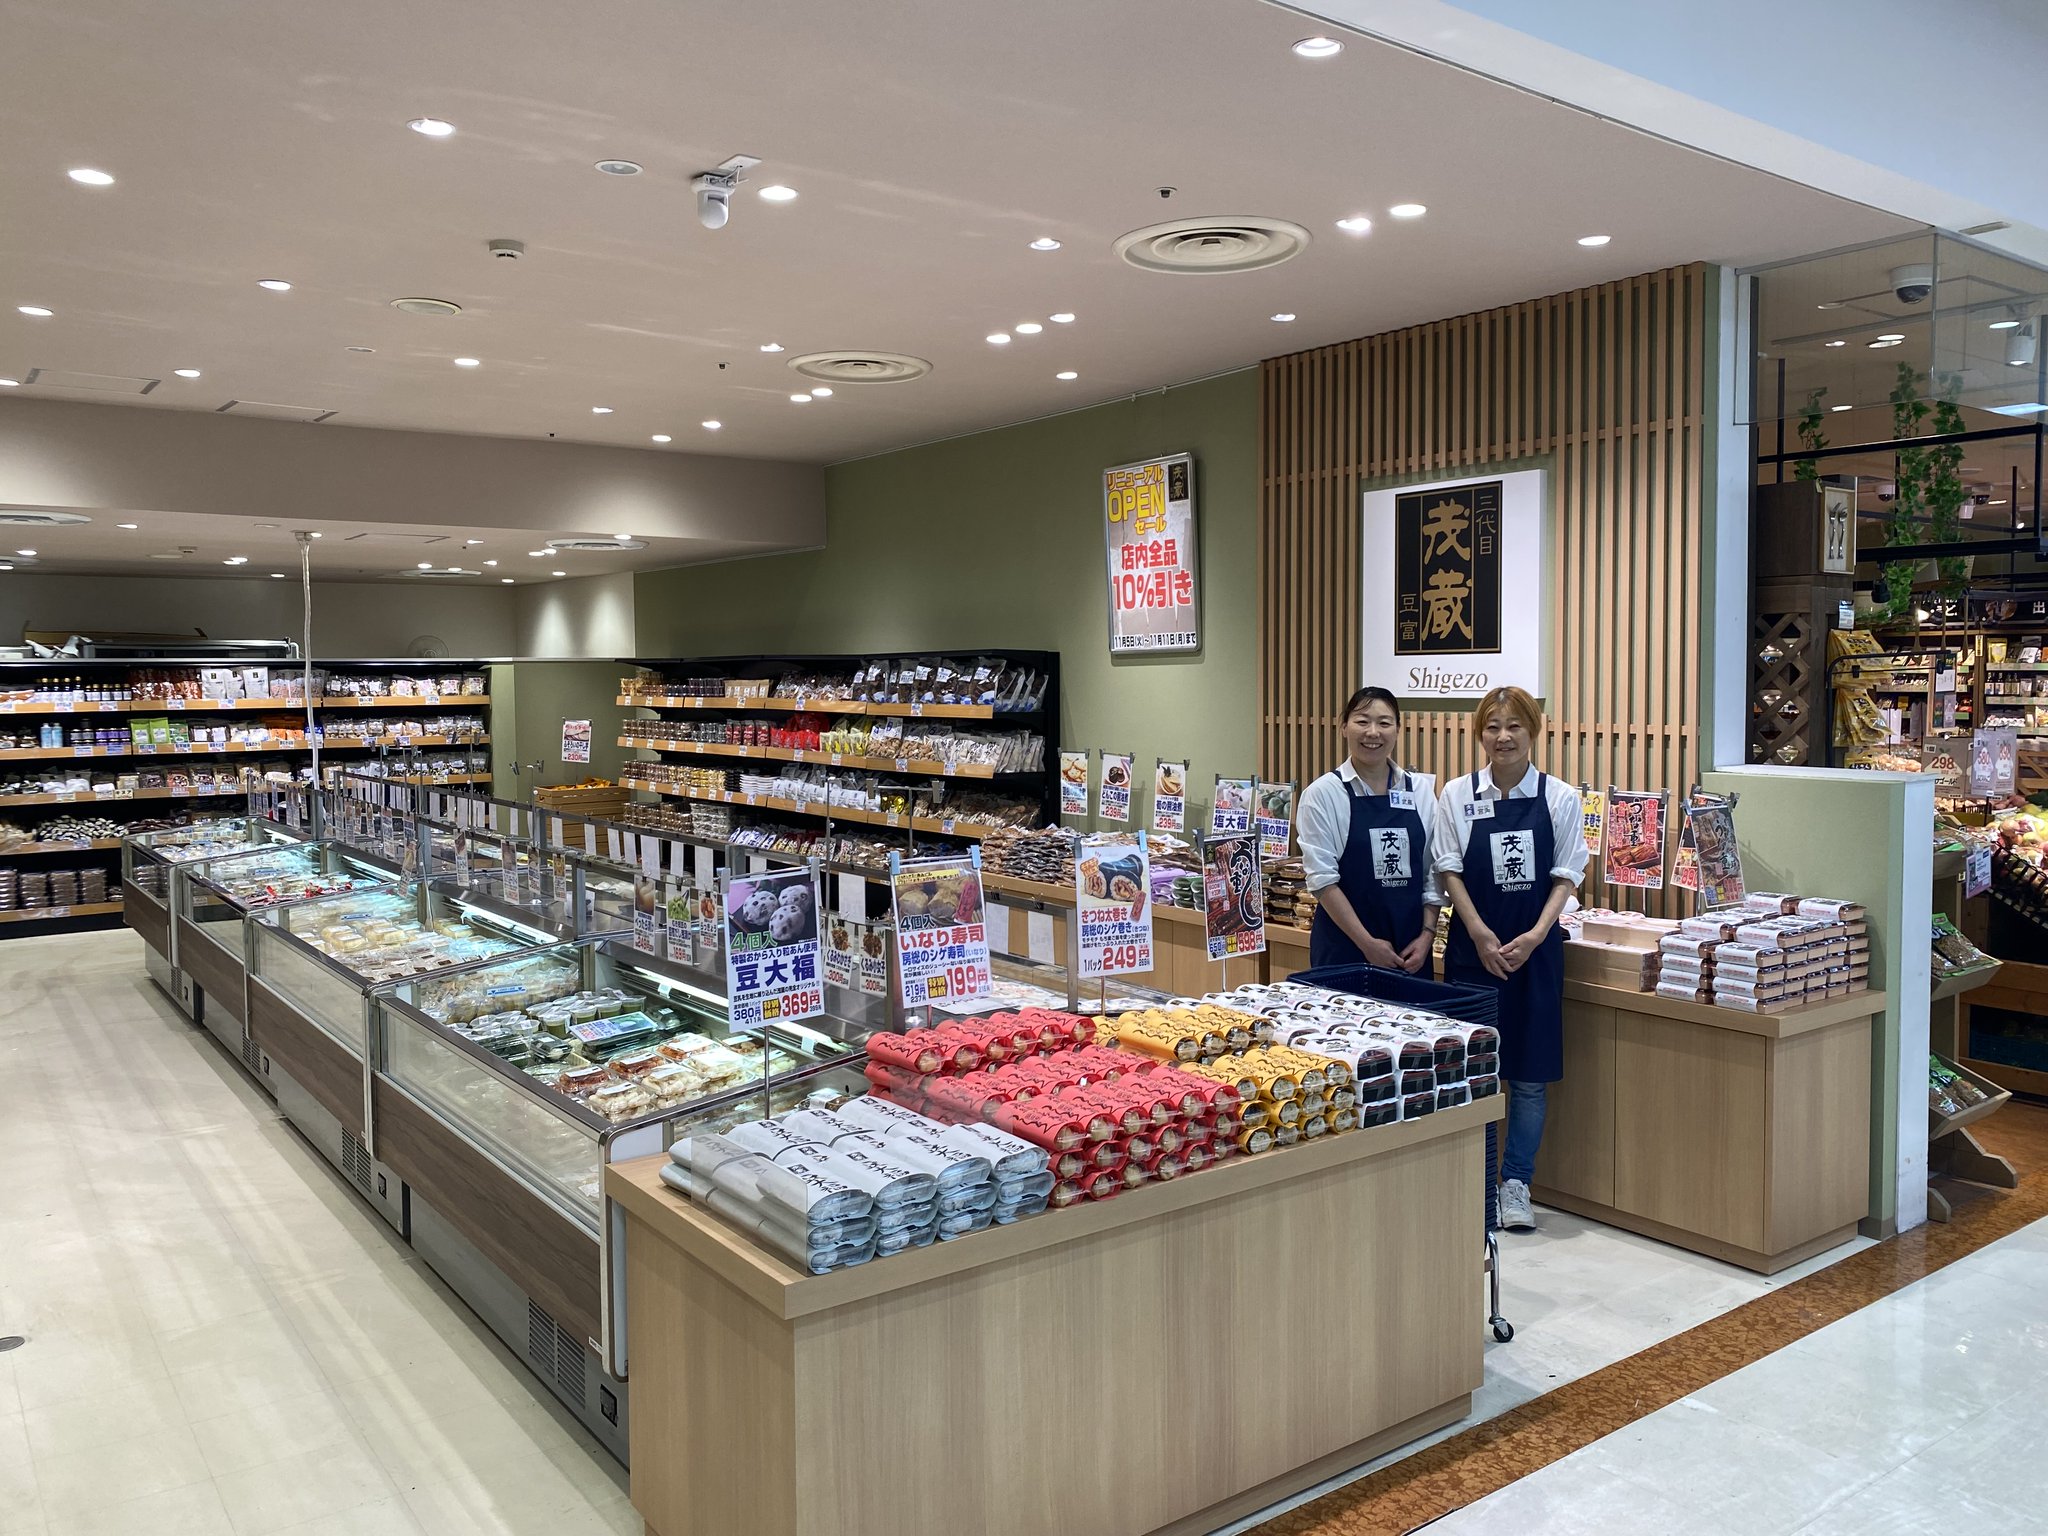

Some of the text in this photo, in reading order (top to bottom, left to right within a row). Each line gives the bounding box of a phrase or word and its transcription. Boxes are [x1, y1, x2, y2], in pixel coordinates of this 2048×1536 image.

[1107, 464, 1164, 490] リニューアル
[1108, 482, 1166, 523] OPEN
[1134, 517, 1166, 535] セール
[1476, 495, 1496, 555] 三代目
[1121, 538, 1178, 570] 店内全品
[1422, 498, 1472, 641] 茂蔵
[1113, 569, 1193, 610] 10%引き
[1400, 593, 1419, 640] 豆富
[1408, 666, 1488, 694] Shigezo
[1932, 756, 1955, 769] 298
[1213, 815, 1247, 830] 塩大福
[1381, 831, 1403, 876] 茂蔵
[1501, 834, 1526, 881] 茂蔵
[1381, 879, 1408, 888] Shigezo
[1501, 883, 1532, 892] Shigezo
[900, 914, 935, 931] 4個入
[1081, 907, 1128, 924] きつね太巻き
[731, 931, 777, 951] 4個入
[900, 924, 985, 951] いなり寿司
[735, 953, 816, 992] 豆大福
